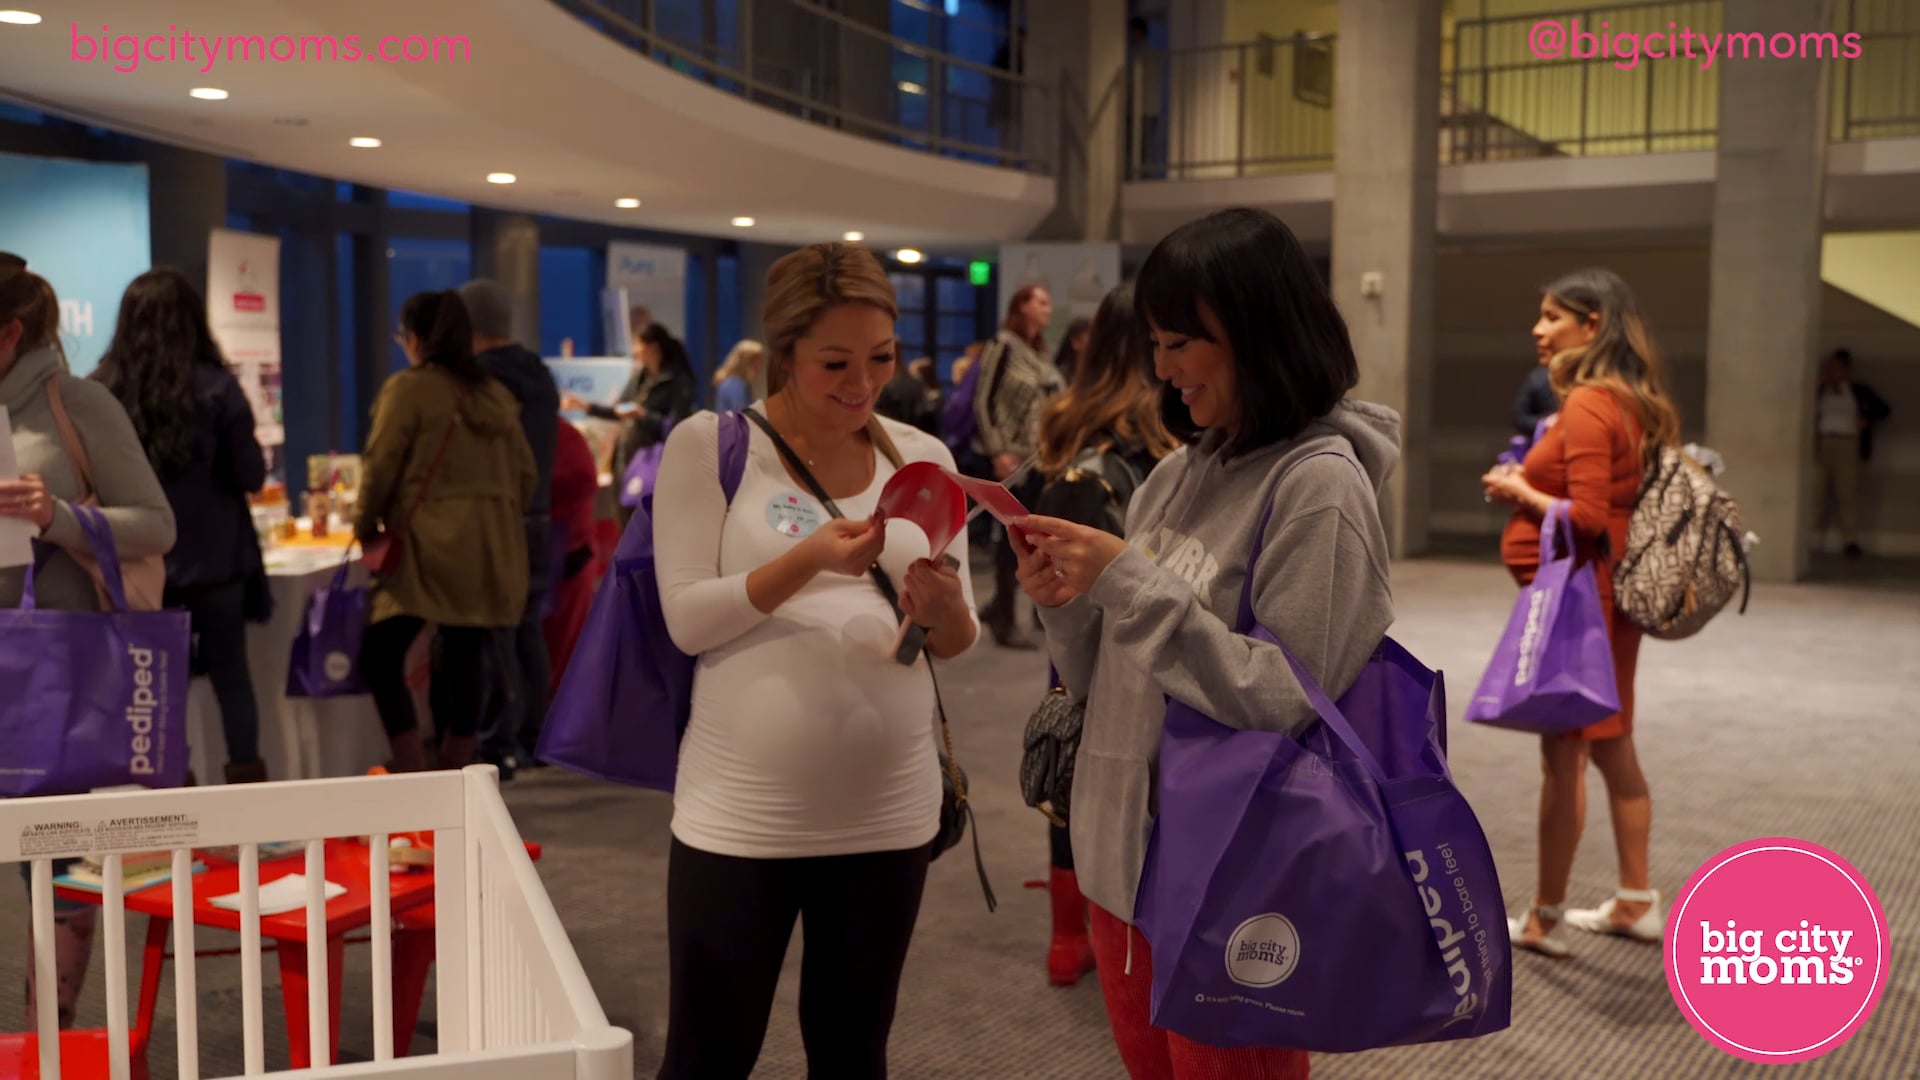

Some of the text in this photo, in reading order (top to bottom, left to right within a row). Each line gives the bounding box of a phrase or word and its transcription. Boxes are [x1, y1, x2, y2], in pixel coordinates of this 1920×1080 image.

[56, 299, 94, 337] TH
[124, 645, 158, 775] pediped
[34, 821, 80, 832] WARNING
[110, 814, 186, 827] AVERTISSEMENT
[1435, 842, 1460, 875] feet
[1453, 876, 1473, 914] bare
[1467, 914, 1480, 931] to
[1236, 950, 1285, 966] moms
[1240, 939, 1287, 956] big city
[1474, 928, 1489, 970] thing
